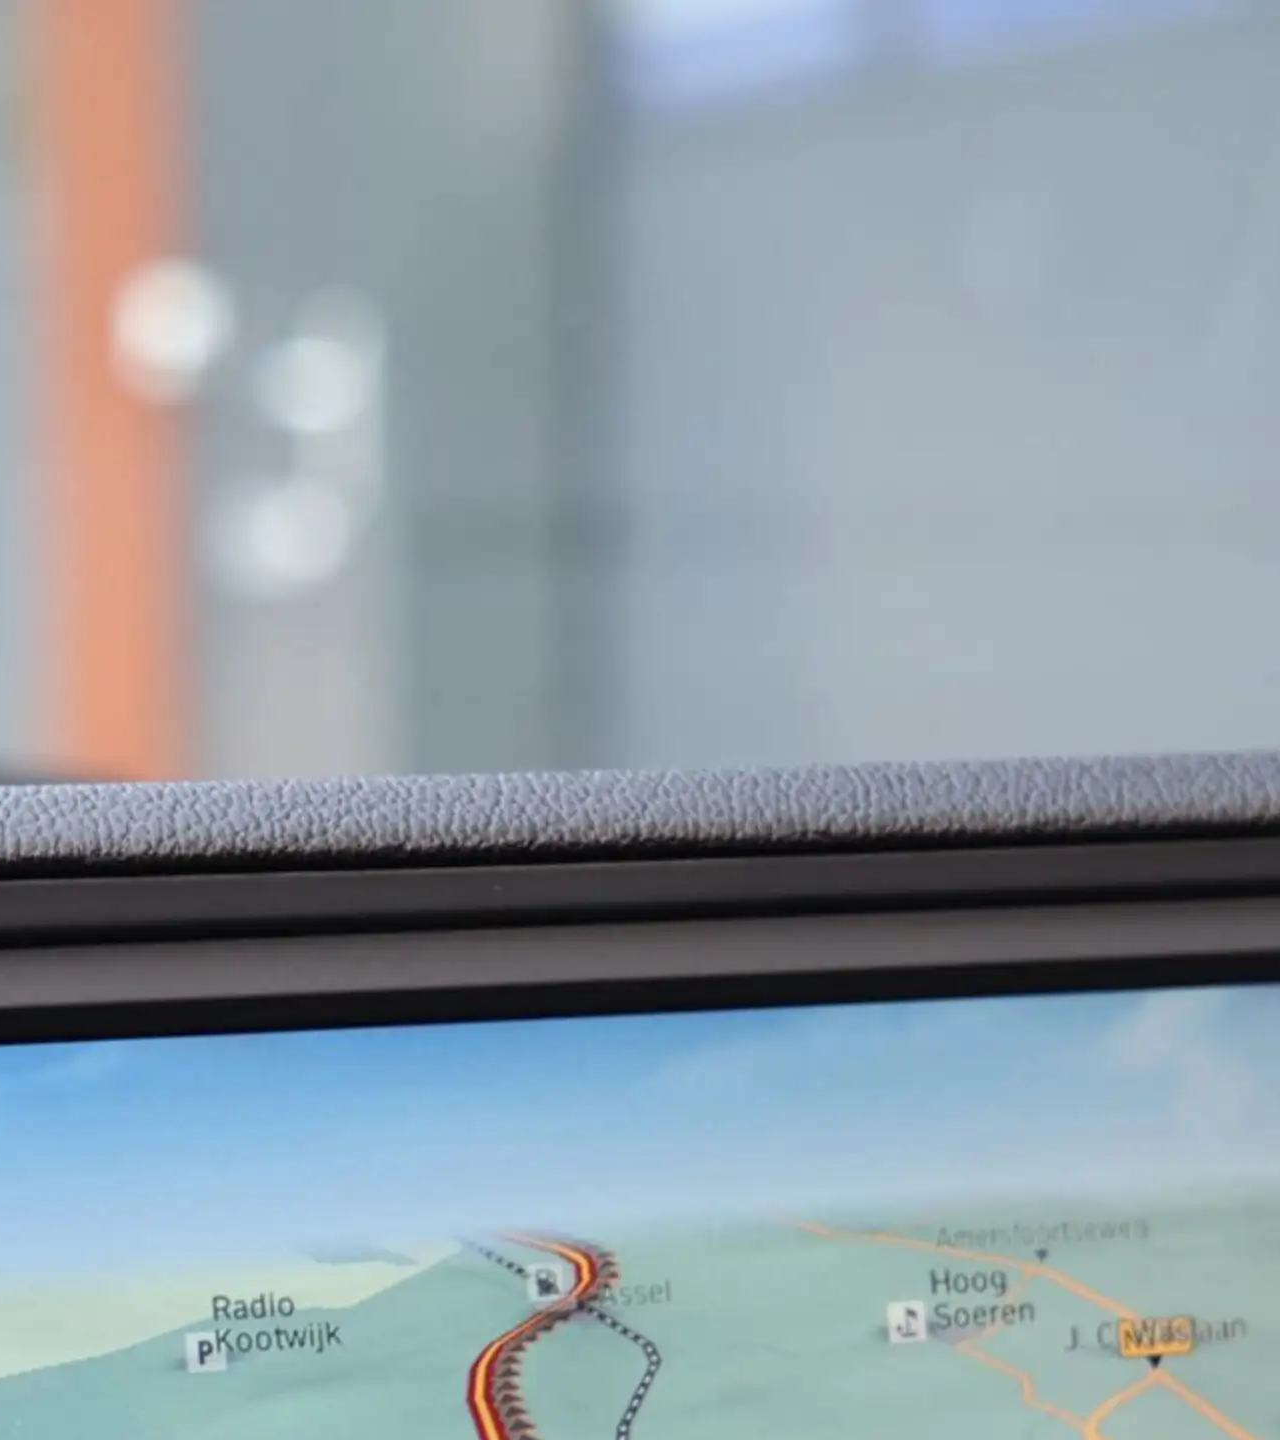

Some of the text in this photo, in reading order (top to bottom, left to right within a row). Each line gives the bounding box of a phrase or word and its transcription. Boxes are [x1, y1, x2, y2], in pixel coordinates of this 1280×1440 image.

[929, 1269, 1008, 1297] Hoog
[211, 1293, 296, 1322] Radio
[932, 1302, 1036, 1331] Soeren
[214, 1322, 342, 1355] Kootwijk
